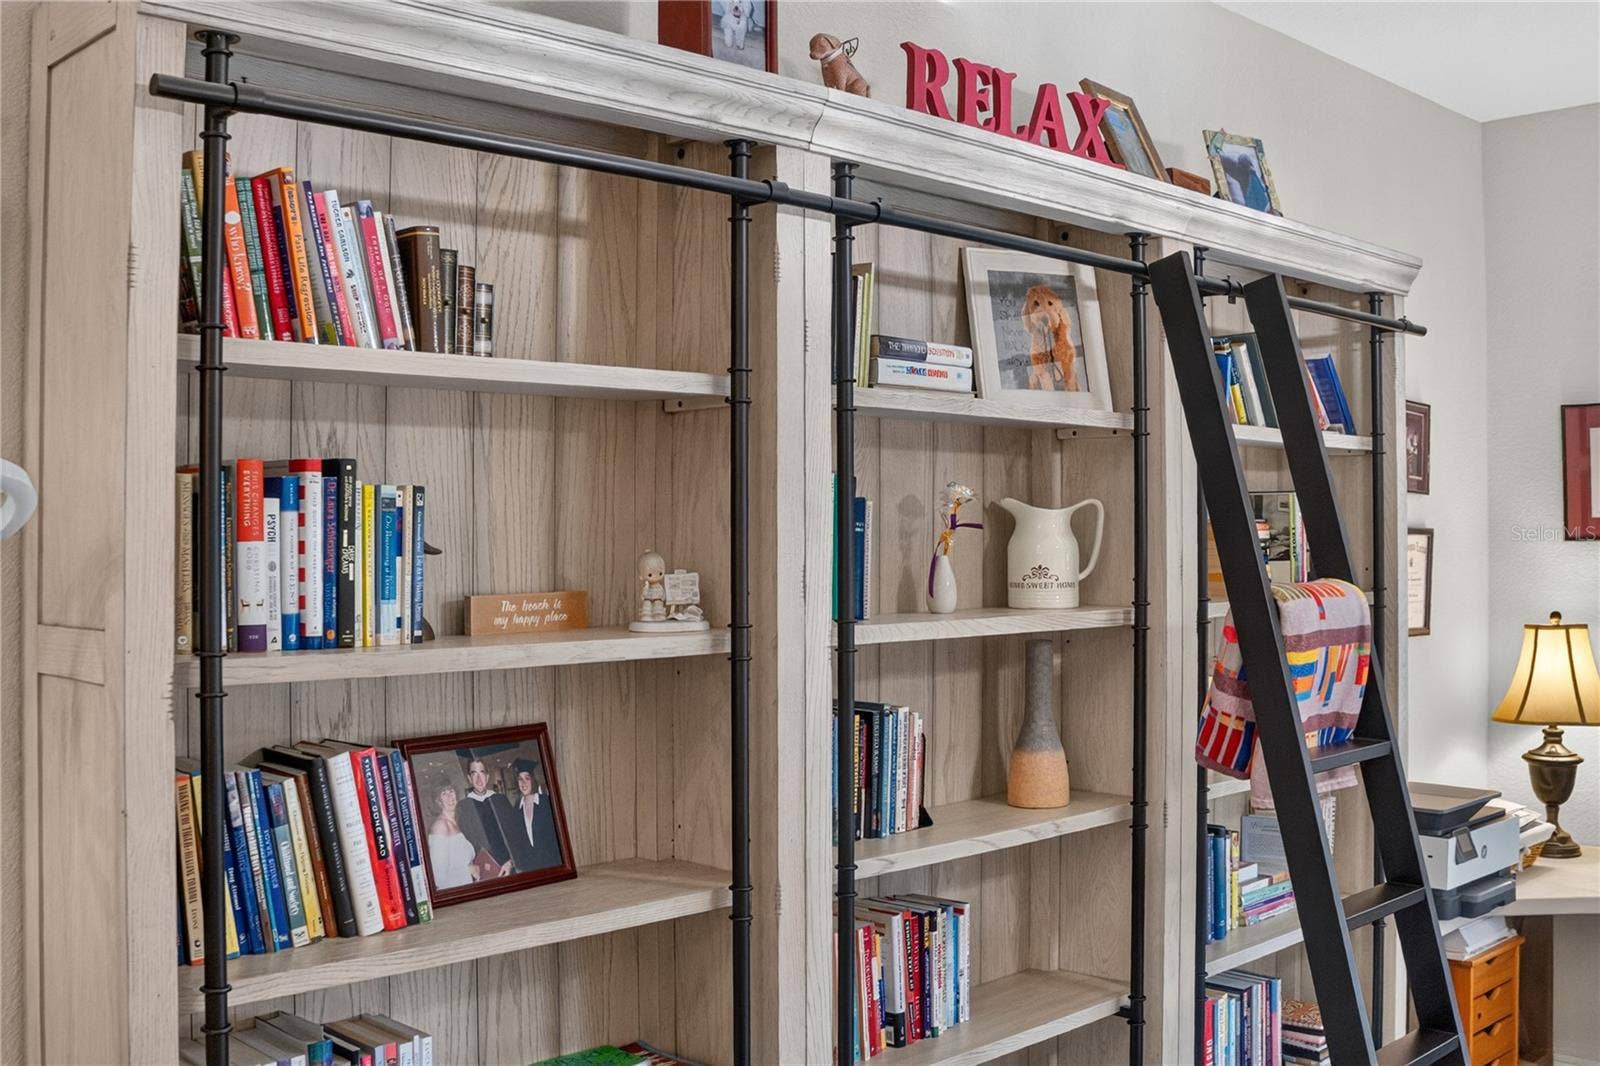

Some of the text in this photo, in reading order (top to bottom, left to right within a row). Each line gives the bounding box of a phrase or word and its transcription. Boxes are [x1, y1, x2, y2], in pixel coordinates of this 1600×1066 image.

[900, 41, 1126, 169] RELAX
[331, 200, 342, 228] TUCKER
[337, 229, 350, 262] CARLSON
[229, 226, 252, 291] who knew?
[294, 234, 313, 327] Past Life Regression
[243, 469, 251, 527] EVERYTHING
[251, 469, 260, 537] THIS CHANGES
[267, 514, 277, 543] PSYCH
[325, 481, 337, 574] Dr. Laura Schlessinger
[384, 515, 393, 529] On
[253, 546, 261, 593] CHRISTINA
[341, 548, 350, 575] DREAMS
[501, 598, 562, 613] The beach is
[1026, 581, 1055, 590] SWEET
[494, 611, 568, 630] my happy place
[181, 813, 191, 826] THE
[364, 758, 387, 857] THERAPY GONE MAD
[400, 796, 411, 826] Positive
[280, 841, 293, 876] Childhood
